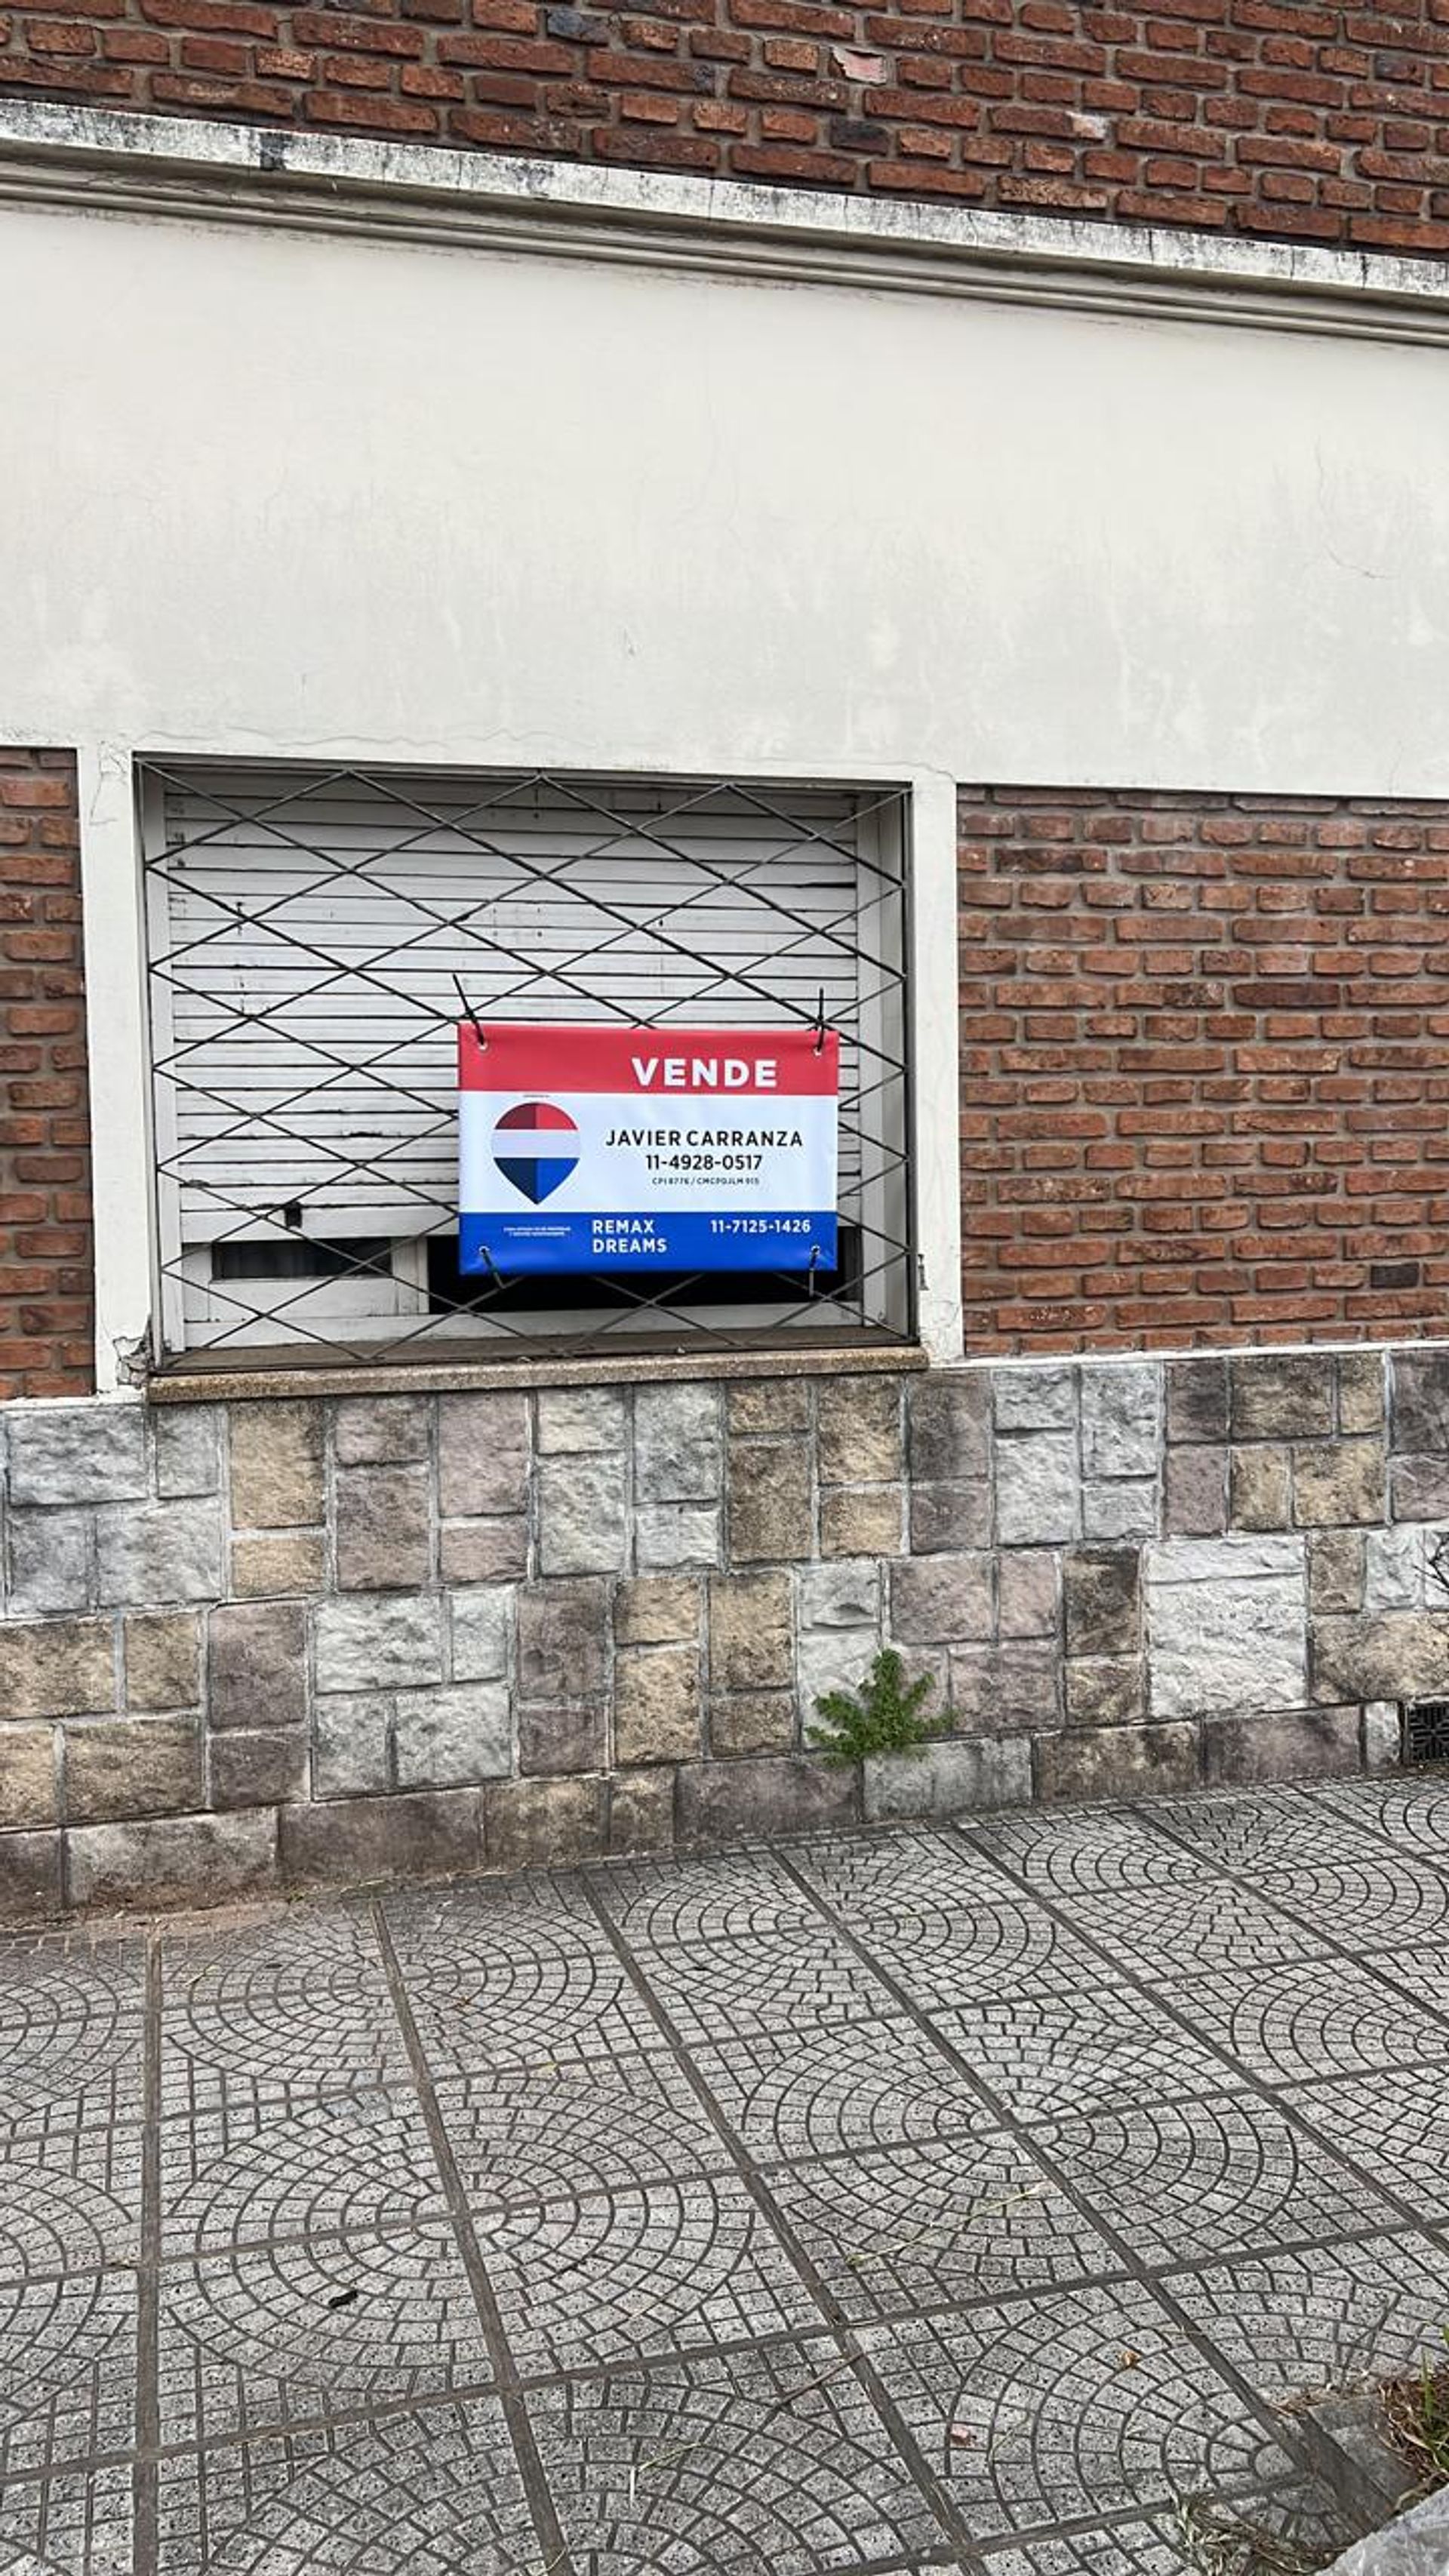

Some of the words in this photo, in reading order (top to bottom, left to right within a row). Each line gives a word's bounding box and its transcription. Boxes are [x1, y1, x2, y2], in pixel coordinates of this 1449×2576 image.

[631, 1057, 777, 1088] VENDE
[605, 1129, 681, 1146] JAVIER
[685, 1131, 803, 1147] CARRANZA
[645, 1154, 762, 1171] 11-4928-0517
[592, 1219, 654, 1235] REMAX
[711, 1219, 811, 1233] 11-7125-1426
[592, 1238, 667, 1253] DREAMS
